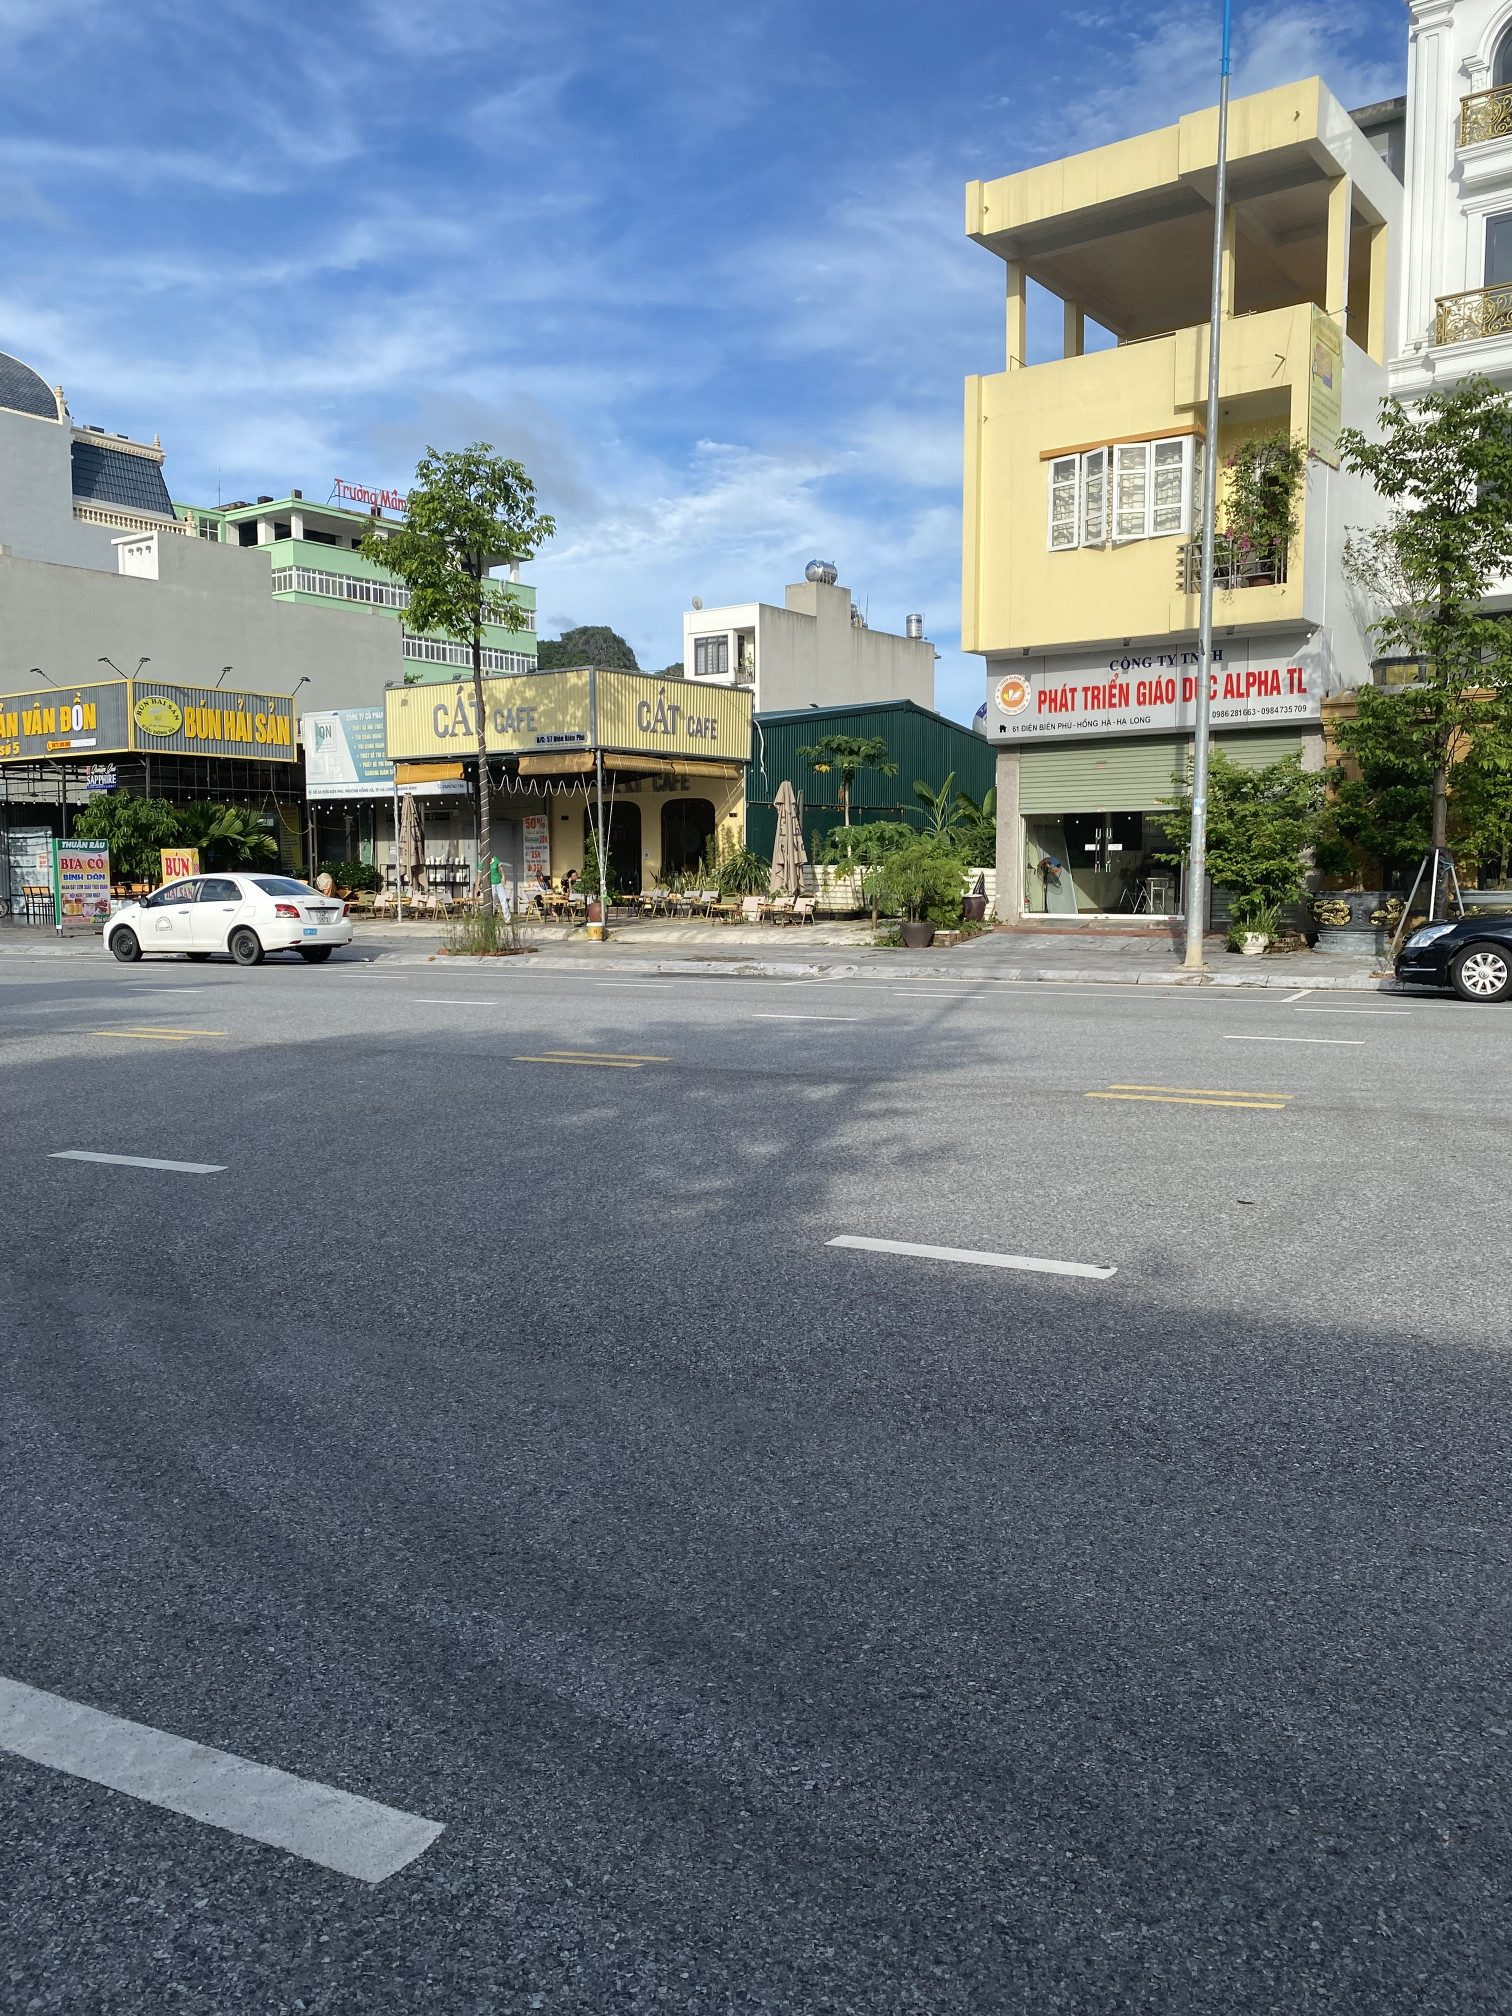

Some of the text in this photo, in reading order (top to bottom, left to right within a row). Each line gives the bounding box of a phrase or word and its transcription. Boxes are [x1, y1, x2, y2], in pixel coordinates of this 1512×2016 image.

[1109, 649, 1223, 671] CÔNG TY TNH
[1038, 667, 1307, 714] PHÁT TRIỂN GIÁO DC ALPHA TL
[494, 706, 537, 733] CAFE
[637, 686, 718, 740] CÁT CAFE
[184, 699, 290, 746] BÚN HẢI SẢN
[1021, 722, 1037, 733] ĐIỆN
[1039, 721, 1055, 731] BIÊN
[1130, 715, 1150, 725] LONG
[319, 726, 332, 739] QN
[13, 742, 20, 755] 5
[87, 774, 117, 785] SAPPHIRE
[61, 841, 88, 850] THUẬN
[60, 858, 83, 869] BIA
[87, 854, 104, 869] CỎ
[165, 852, 189, 876] BÚN
[87, 873, 105, 881] DÂN
